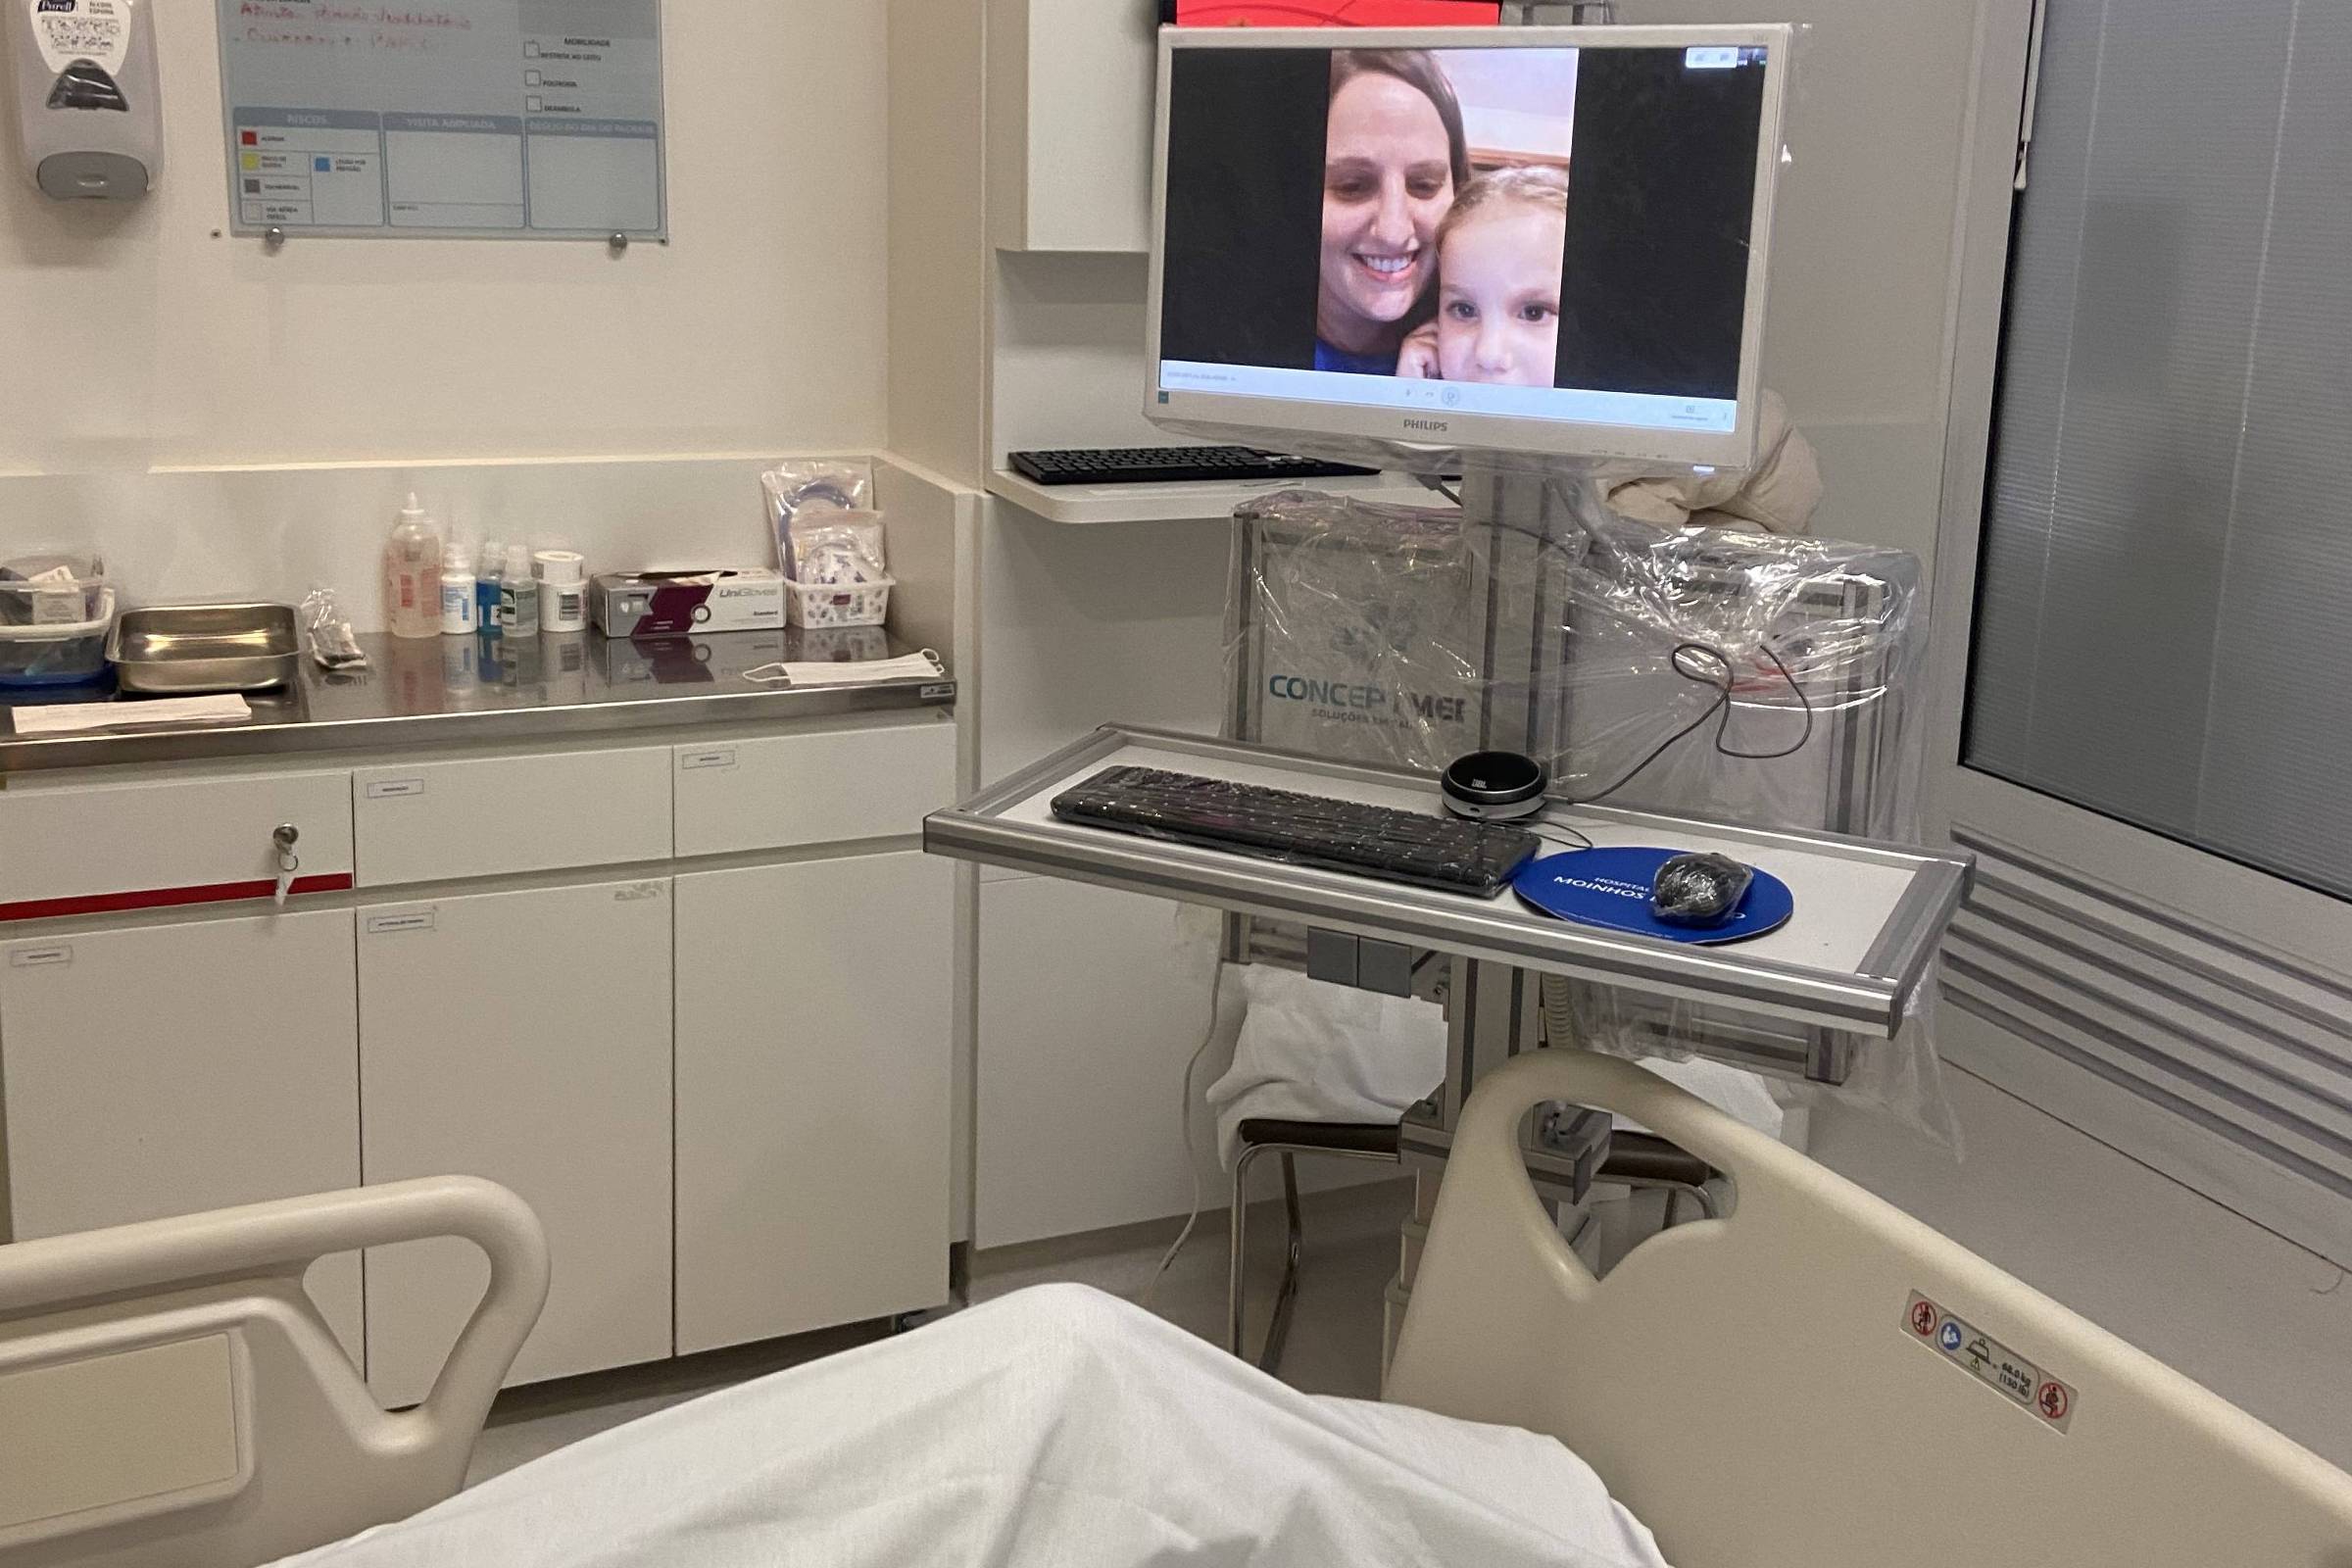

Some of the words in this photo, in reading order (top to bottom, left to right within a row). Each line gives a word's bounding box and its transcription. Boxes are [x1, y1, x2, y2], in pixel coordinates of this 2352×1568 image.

[1402, 418, 1448, 432] PHILIPS
[1553, 875, 1647, 901] MOINHOS
[2021, 1371, 2032, 1389] kg
